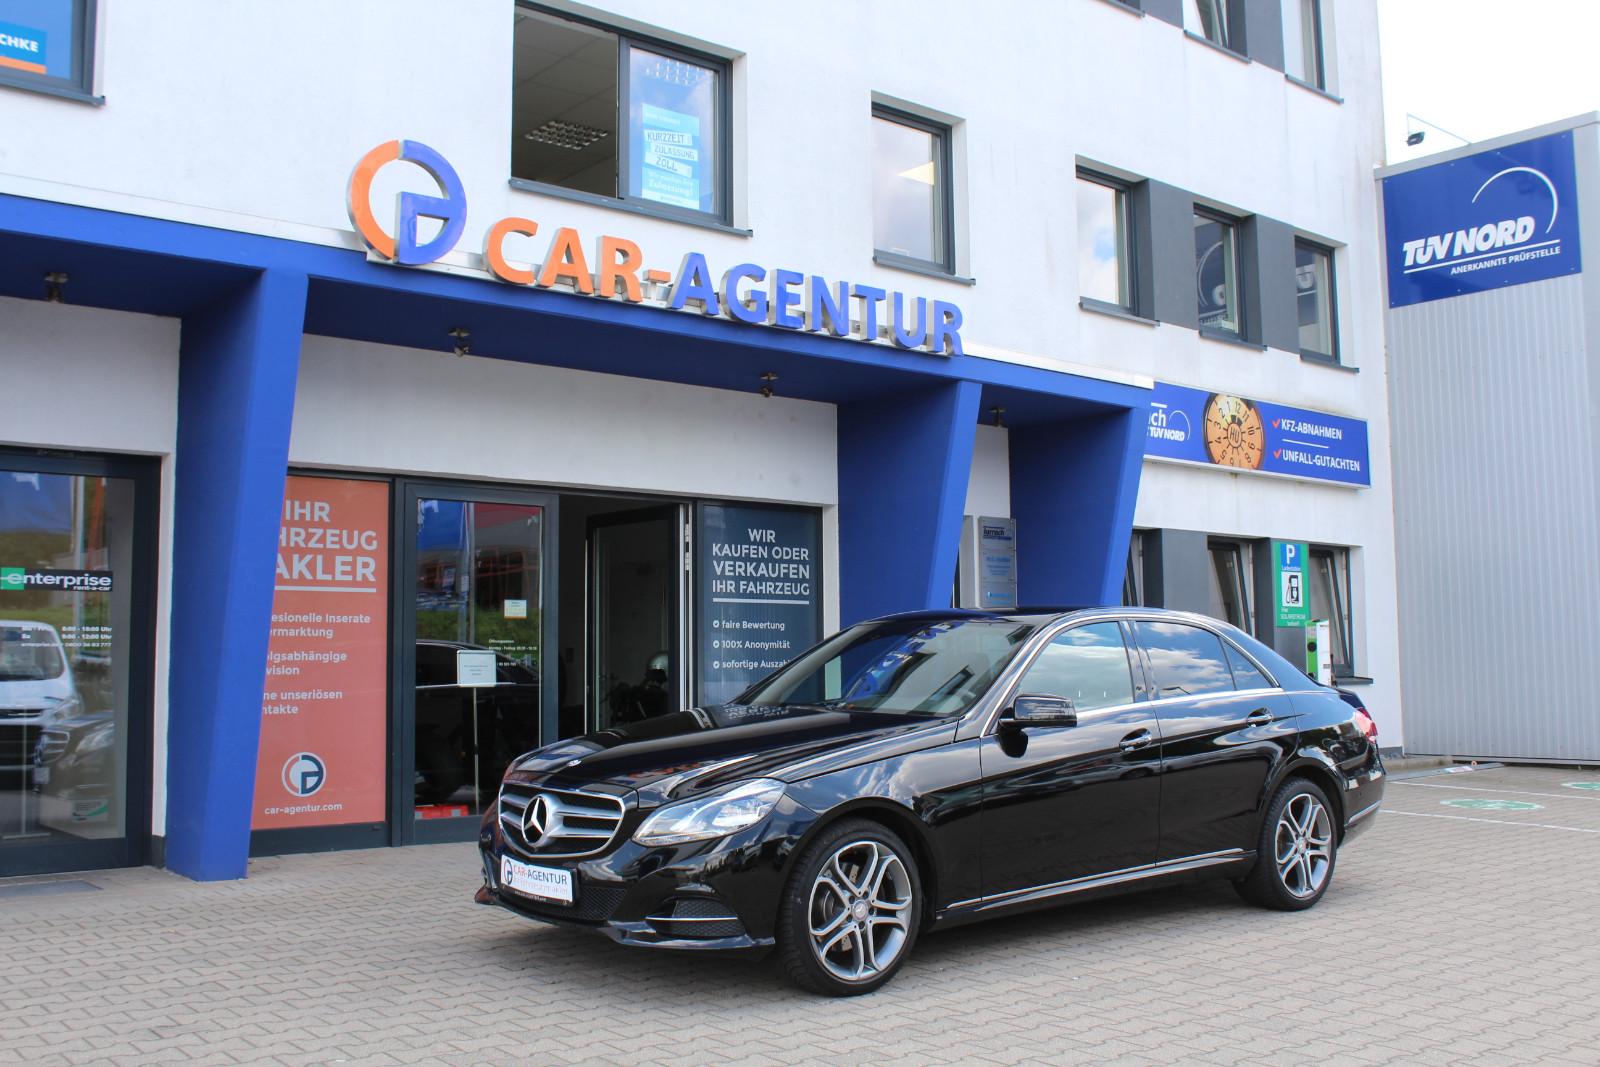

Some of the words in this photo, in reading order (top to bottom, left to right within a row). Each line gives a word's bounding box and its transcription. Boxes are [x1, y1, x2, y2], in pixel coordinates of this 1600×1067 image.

[0, 34, 39, 53] CHKE
[647, 132, 684, 144] KURZZEIT
[654, 145, 695, 160] ZULASSUNG
[656, 156, 678, 171] ZOLL
[1403, 232, 1454, 267] TÜV
[1454, 216, 1535, 251] NORD
[1450, 257, 1508, 275] ANERKANNTE
[1508, 245, 1560, 264] PRÜFSTELLE
[483, 217, 964, 355] CAR-AGENTUR
[1163, 428, 1185, 442] NORD
[1281, 418, 1342, 440] KFZ-ABNAHMEN
[1282, 449, 1361, 472] UNFALL-GUTACHTEN
[285, 500, 331, 522] IHR
[748, 528, 776, 543] WIR
[713, 543, 767, 558] KAUFEN
[772, 547, 808, 560] ODER
[1286, 544, 1296, 565] P
[713, 560, 810, 578] VERKAUFEN
[8, 573, 112, 588] enterprise
[712, 580, 736, 593] IHR
[740, 581, 810, 595] FAHRZEUG
[326, 613, 371, 624] Inserate
[722, 620, 740, 629] faire
[742, 621, 785, 631] Bewertung
[271, 627, 334, 639] rmarktung
[722, 640, 742, 648] 100%
[745, 640, 790, 650] Anonymität
[268, 650, 348, 663] lgsabhängige
[722, 660, 759, 670] sofortige
[280, 688, 343, 700] unseriösen
[264, 803, 342, 815] car-agentur.com
[514, 865, 567, 884] CAR-AGENTUR
